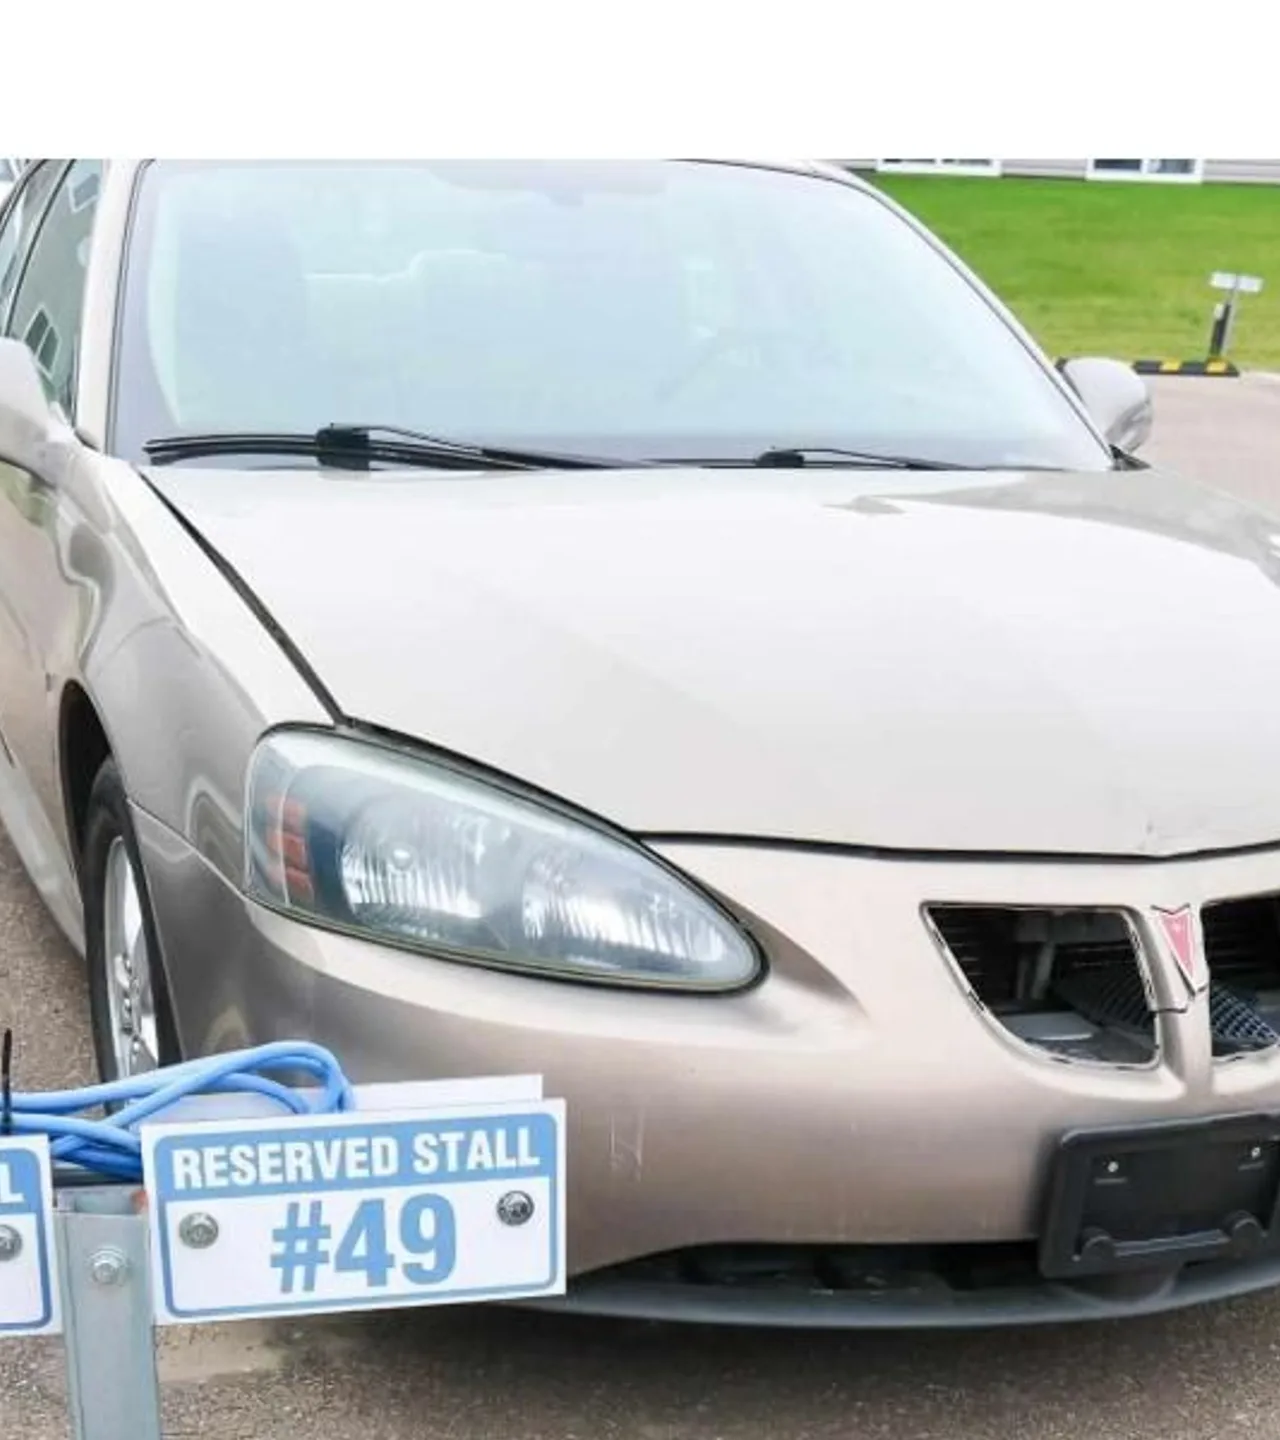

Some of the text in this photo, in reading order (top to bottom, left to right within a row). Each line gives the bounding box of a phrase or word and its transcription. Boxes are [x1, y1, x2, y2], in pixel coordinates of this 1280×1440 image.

[171, 1126, 540, 1190] RESERVED STALL
[269, 1192, 457, 1294] #49
